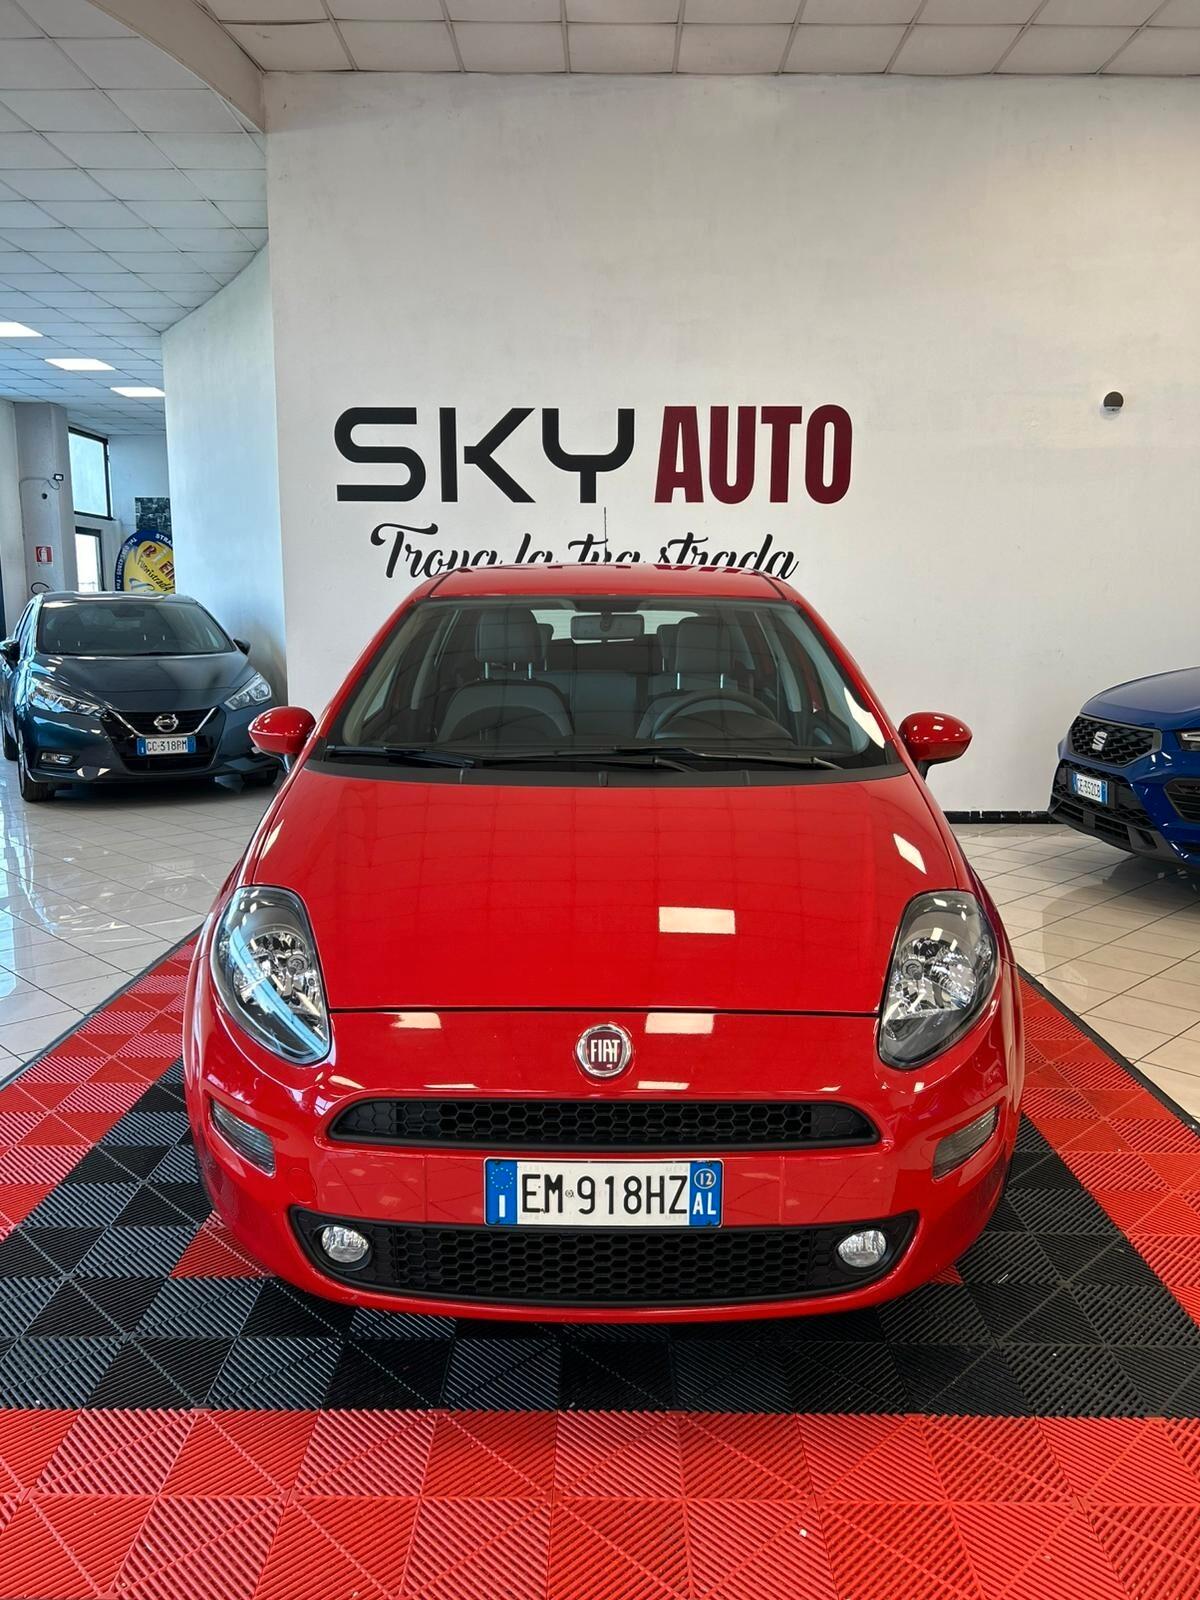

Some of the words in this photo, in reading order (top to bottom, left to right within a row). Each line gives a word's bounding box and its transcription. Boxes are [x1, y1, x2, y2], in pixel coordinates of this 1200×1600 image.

[334, 407, 635, 503] SKY
[654, 404, 853, 504] AUTO
[155, 533, 173, 547] STRA
[590, 1039, 621, 1062] FIAT
[700, 1172, 713, 1186] 12
[521, 1174, 563, 1214] EM
[577, 1175, 688, 1215] 918HZ
[692, 1192, 716, 1215] AL
